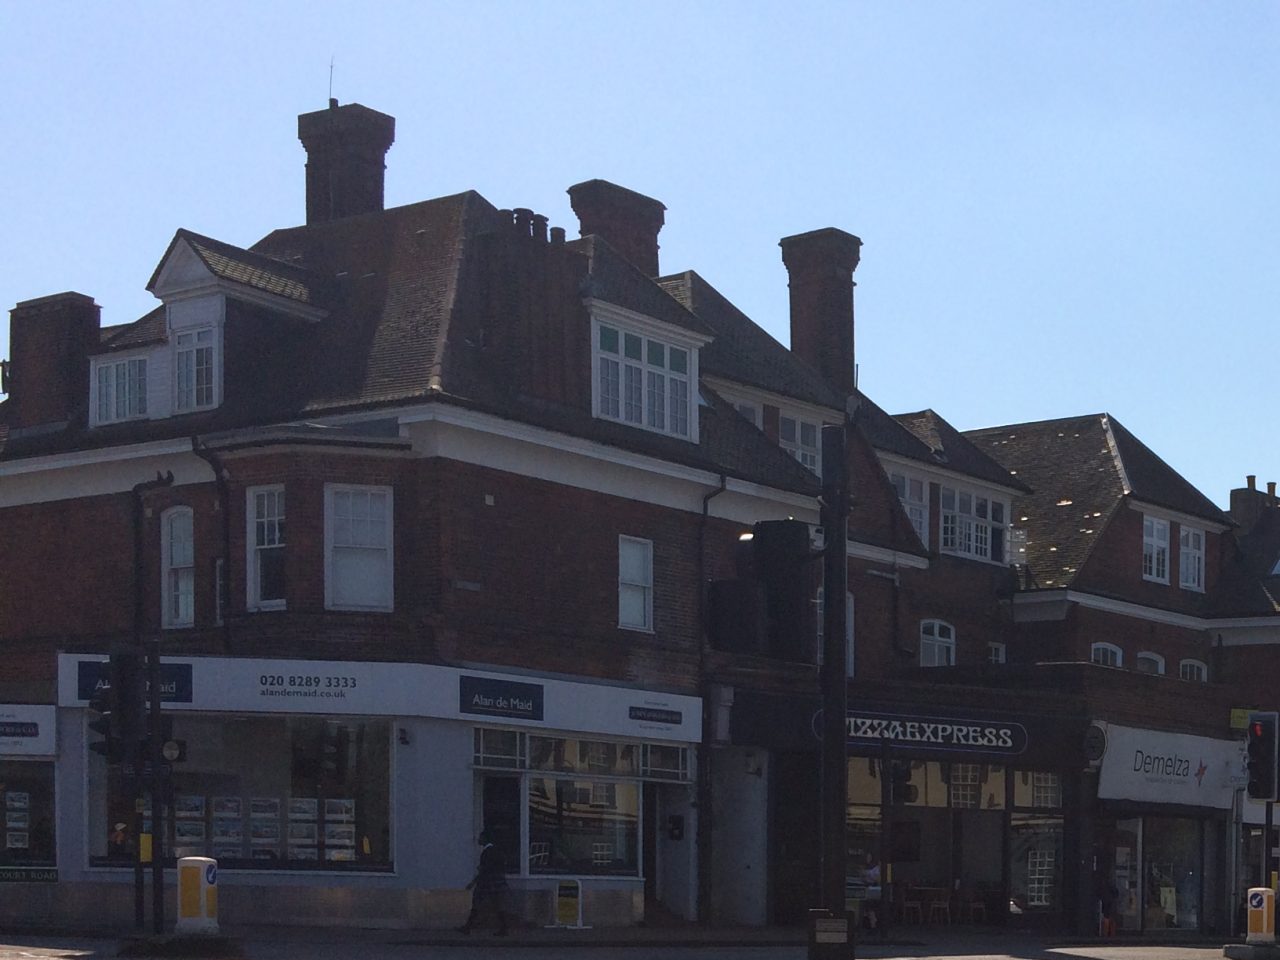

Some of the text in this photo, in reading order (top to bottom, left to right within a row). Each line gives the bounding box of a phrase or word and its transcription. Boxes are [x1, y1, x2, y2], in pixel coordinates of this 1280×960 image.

[259, 675, 357, 689] 020 8289 3333
[259, 688, 347, 699] alandemaid.co.uk
[472, 693, 533, 711] Alan de Maid
[845, 716, 1014, 749] IZZAEXPRESS
[1133, 749, 1190, 777] Demelza
